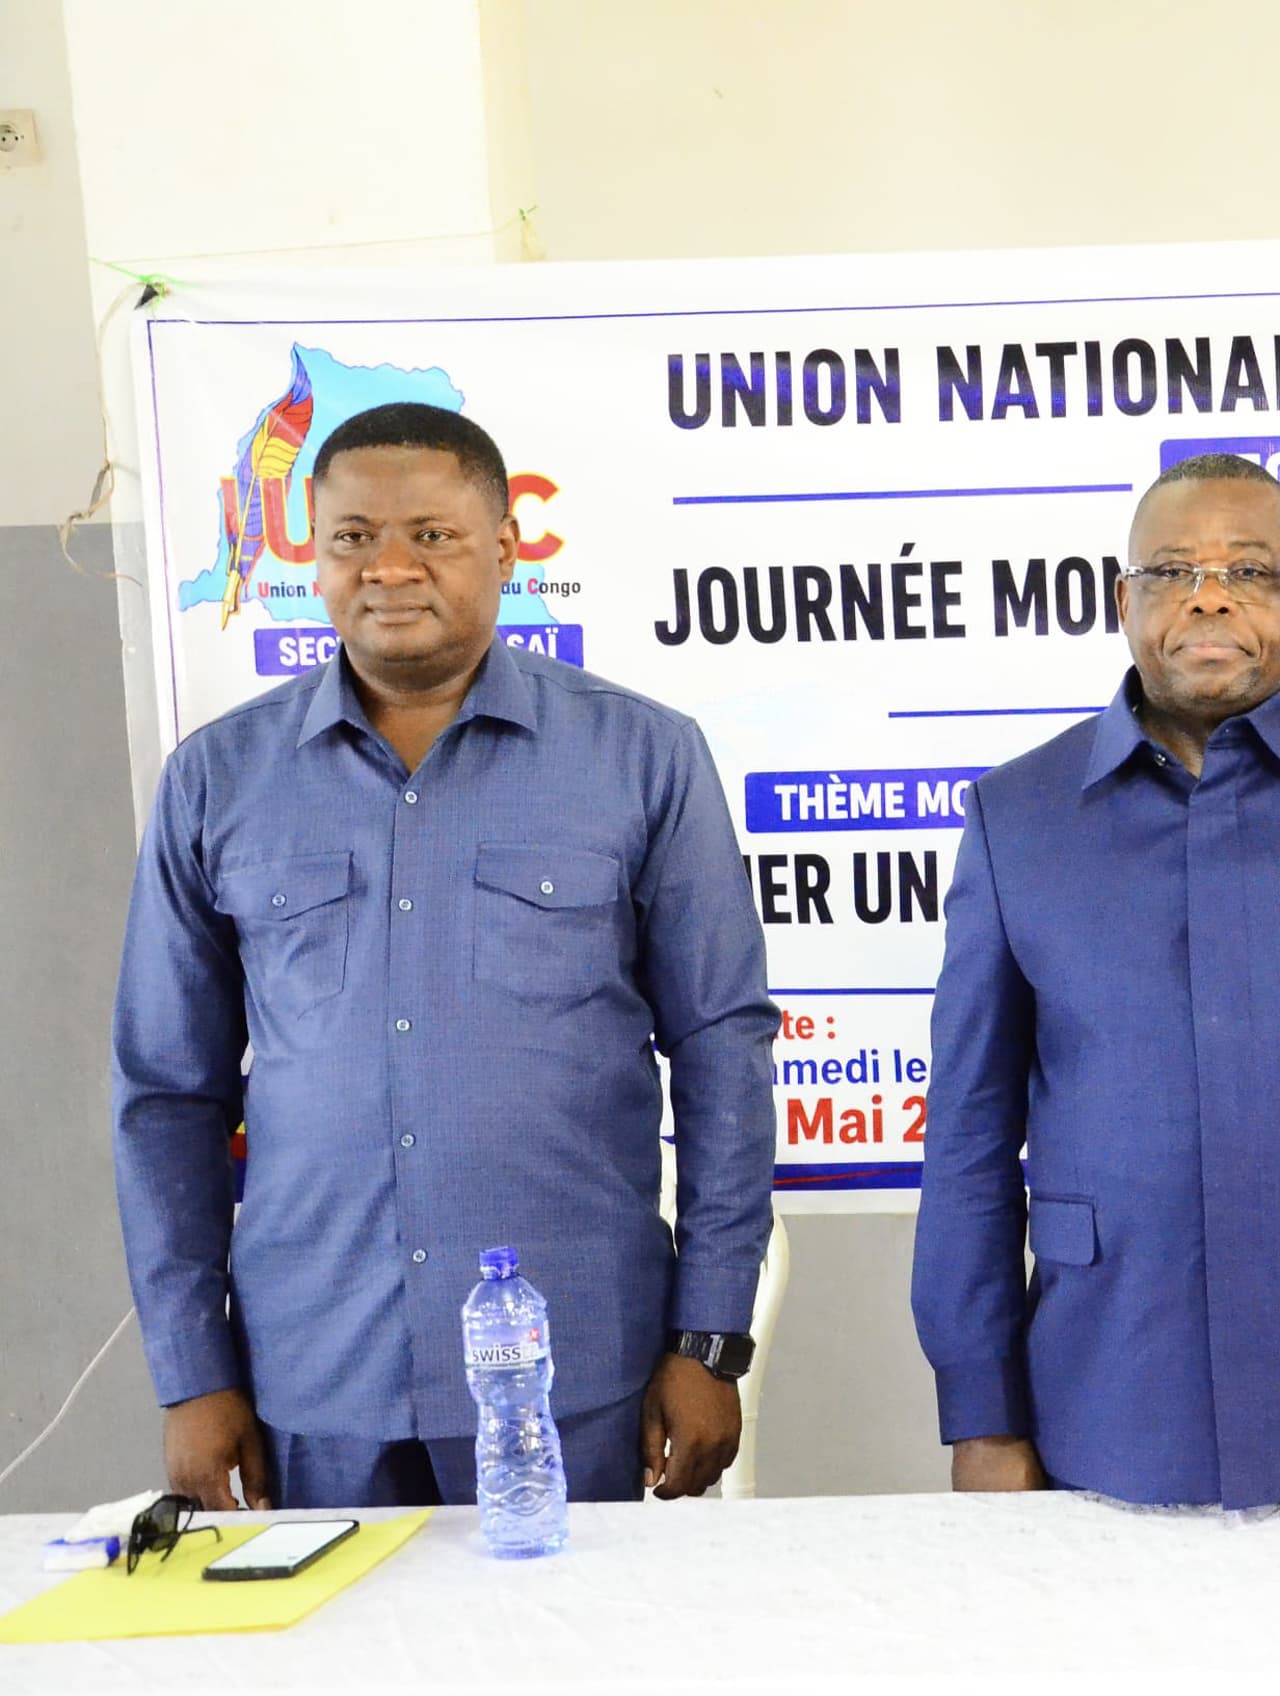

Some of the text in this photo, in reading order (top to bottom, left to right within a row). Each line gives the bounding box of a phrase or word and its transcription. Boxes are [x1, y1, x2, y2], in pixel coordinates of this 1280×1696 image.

[668, 348, 902, 430] UNION
[257, 581, 307, 598] Union
[527, 578, 582, 598] Congo
[654, 542, 966, 646] JOURNÉE
[278, 636, 339, 667] SEC
[774, 774, 906, 821] THÈME
[853, 851, 939, 924] UN
[894, 1049, 927, 1083] le
[787, 1094, 883, 1145] Mai
